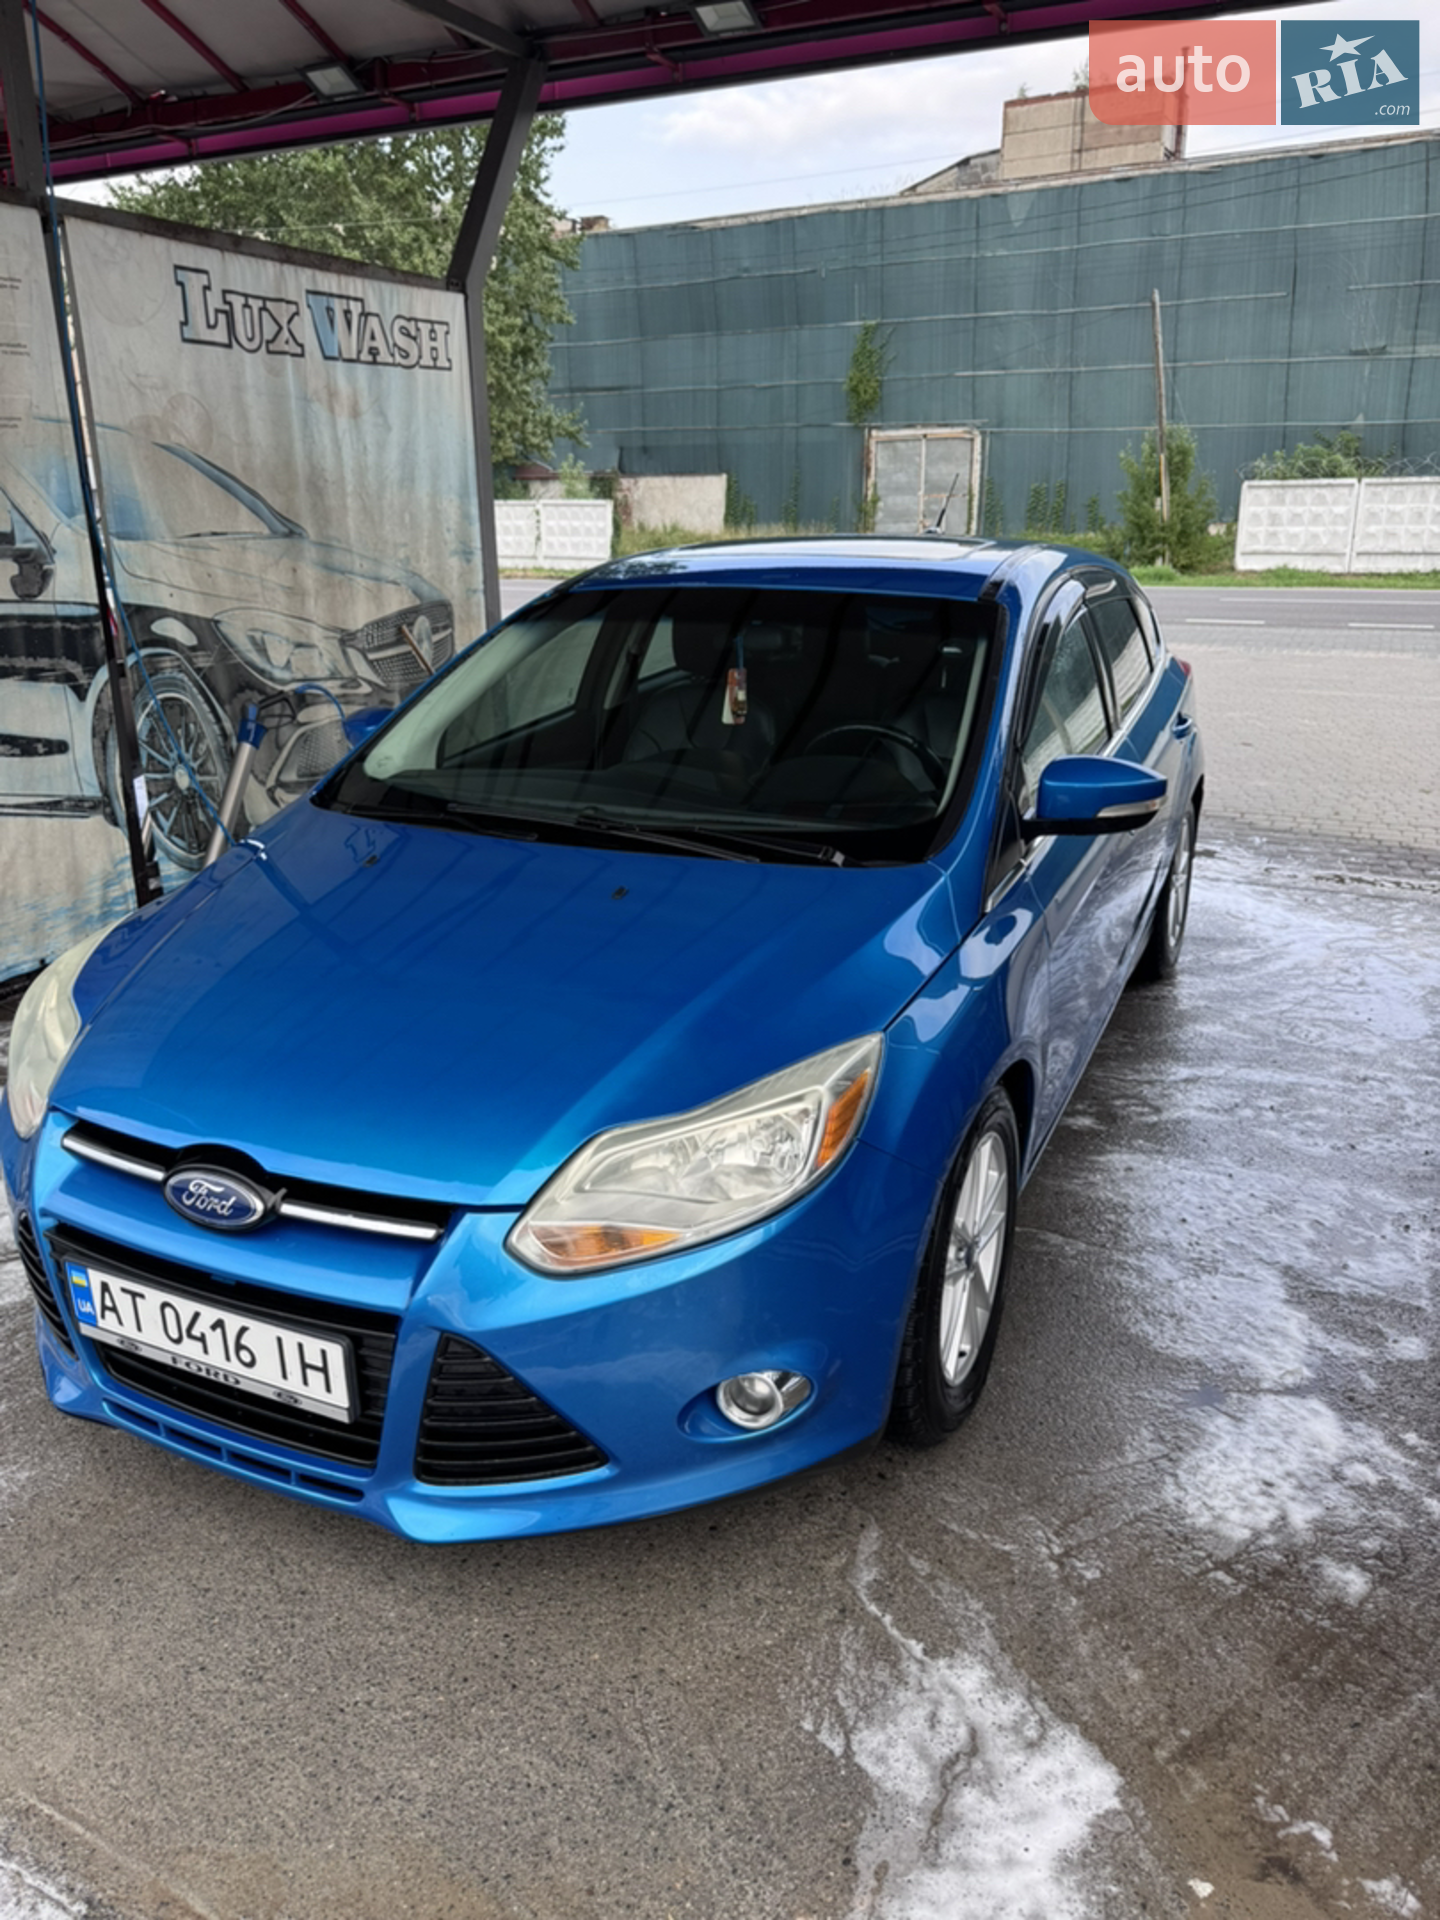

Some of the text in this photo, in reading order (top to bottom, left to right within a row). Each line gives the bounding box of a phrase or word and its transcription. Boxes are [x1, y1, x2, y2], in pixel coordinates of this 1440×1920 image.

[182, 1179, 237, 1217] Ford
[77, 1298, 95, 1316] UA
[100, 1280, 332, 1395] AT 0416 IH
[170, 1355, 242, 1386] FORD
